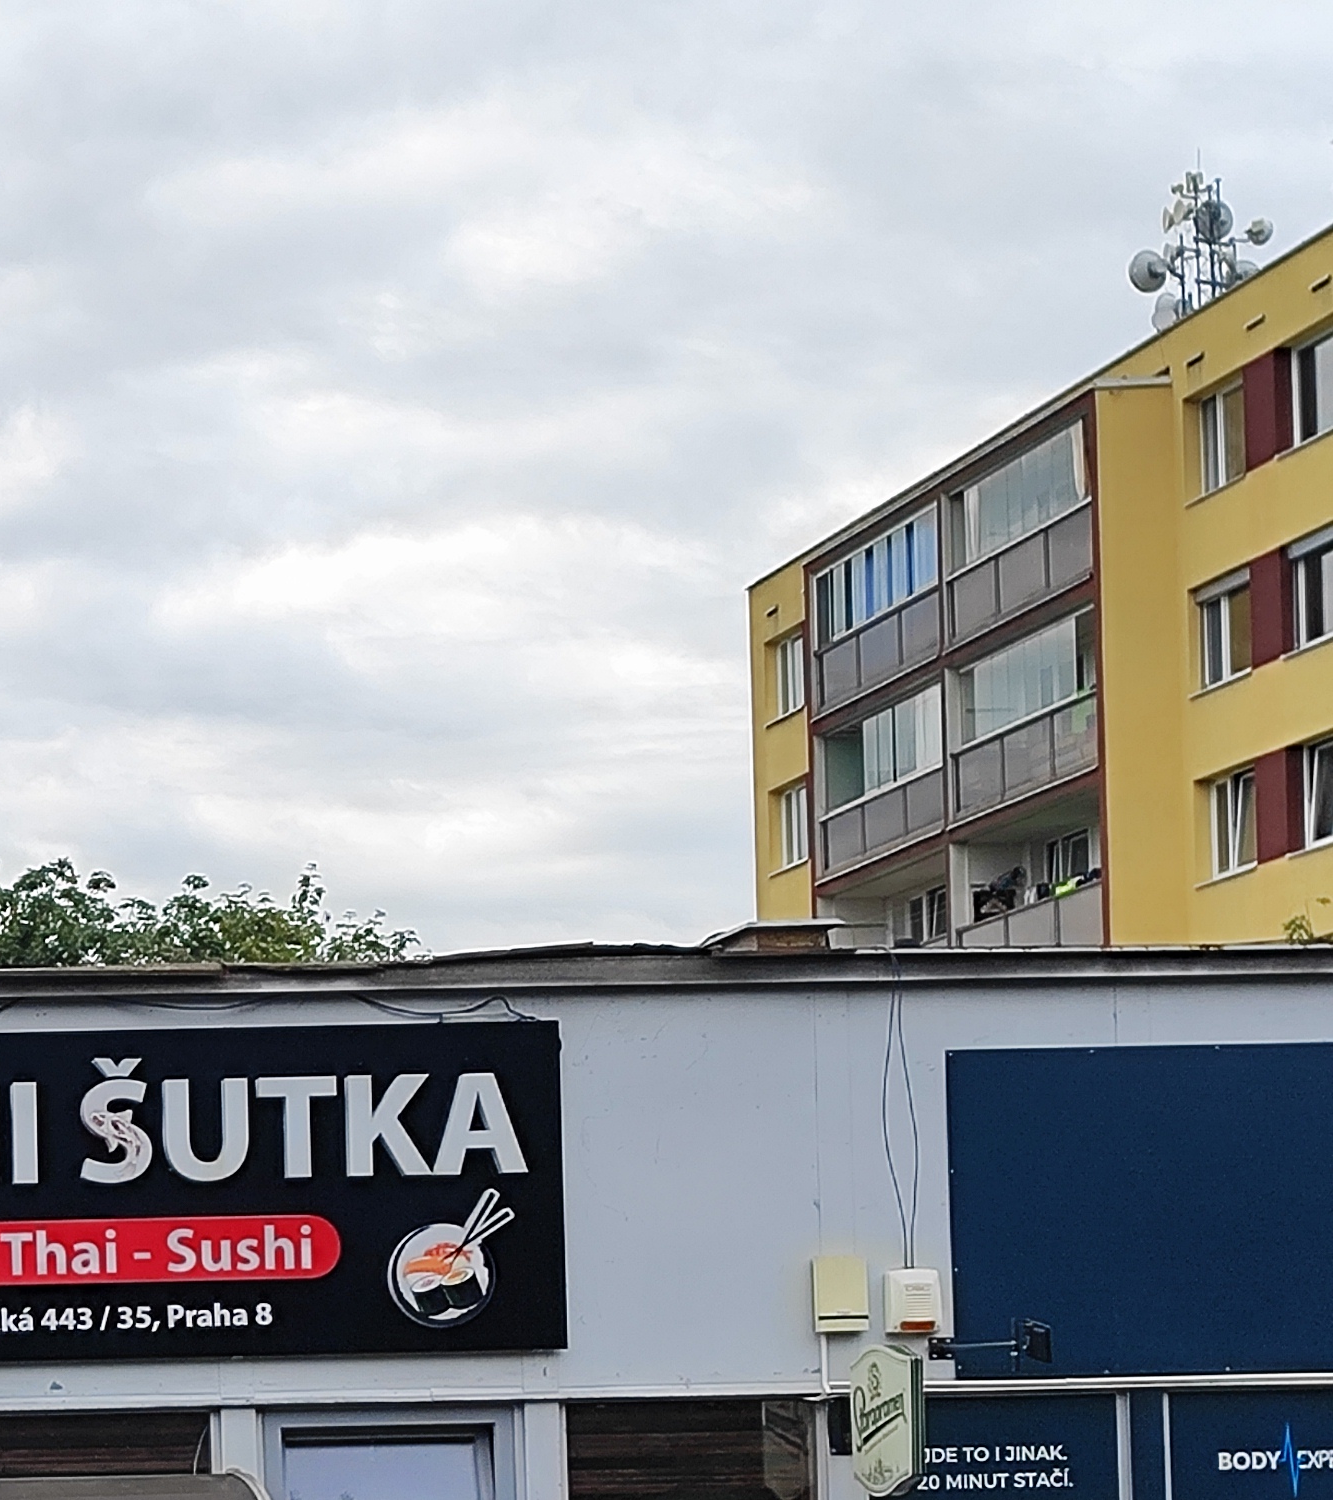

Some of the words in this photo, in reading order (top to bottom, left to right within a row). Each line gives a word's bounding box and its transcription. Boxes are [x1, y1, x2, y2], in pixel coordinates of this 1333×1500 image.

[79, 1057, 529, 1184] ŠUTKA
[0, 1228, 118, 1276] Thai
[166, 1224, 313, 1274] Sushi
[40, 1306, 93, 1331] 443
[116, 1305, 161, 1332] 35,
[166, 1301, 249, 1330] Praha
[254, 1301, 274, 1327] 8
[962, 1446, 990, 1463] TO
[995, 1446, 1001, 1462] I
[1004, 1444, 1068, 1462] JINAK.
[1217, 1450, 1282, 1471] BODY
[916, 1474, 940, 1491] 20
[945, 1472, 1010, 1490] MINUT
[1013, 1467, 1074, 1488] STAČÍ.
